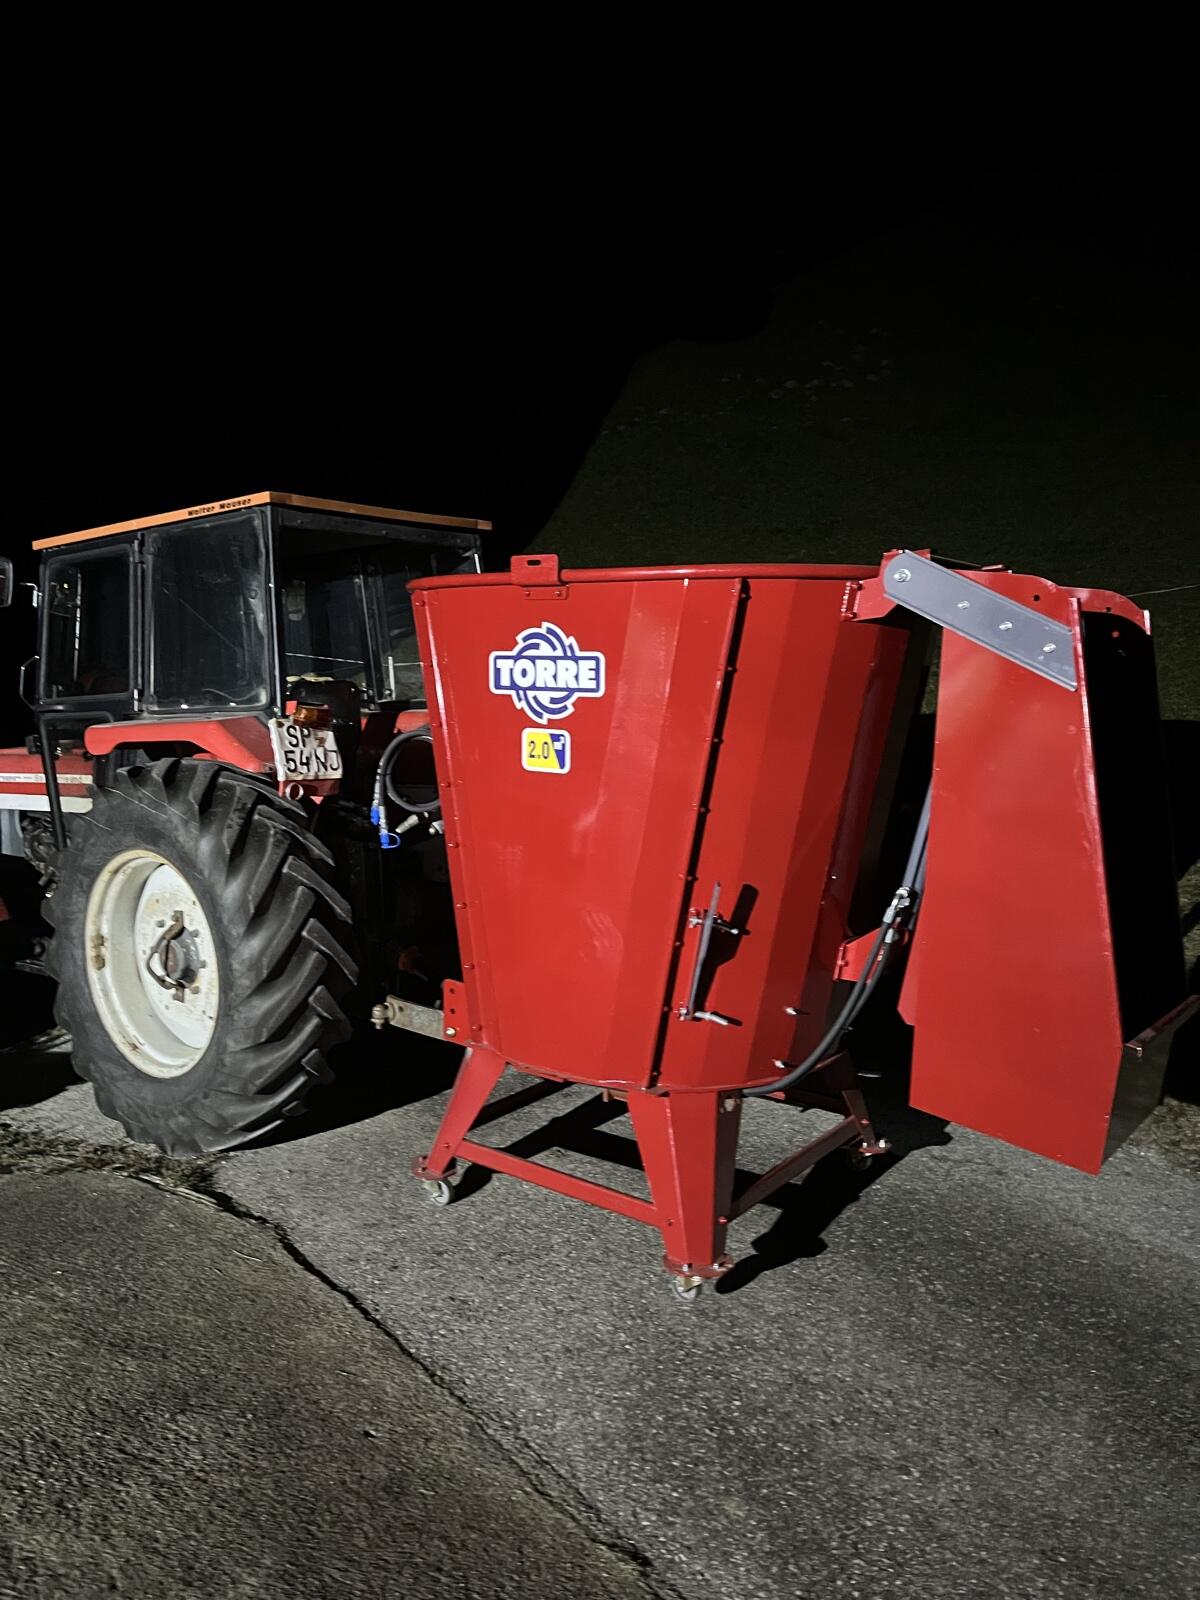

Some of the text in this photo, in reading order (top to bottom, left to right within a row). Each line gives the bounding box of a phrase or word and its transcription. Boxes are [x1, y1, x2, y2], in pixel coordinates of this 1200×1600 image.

[496, 658, 596, 688] TORRE
[286, 725, 311, 748] SP
[528, 740, 550, 759] 2.0
